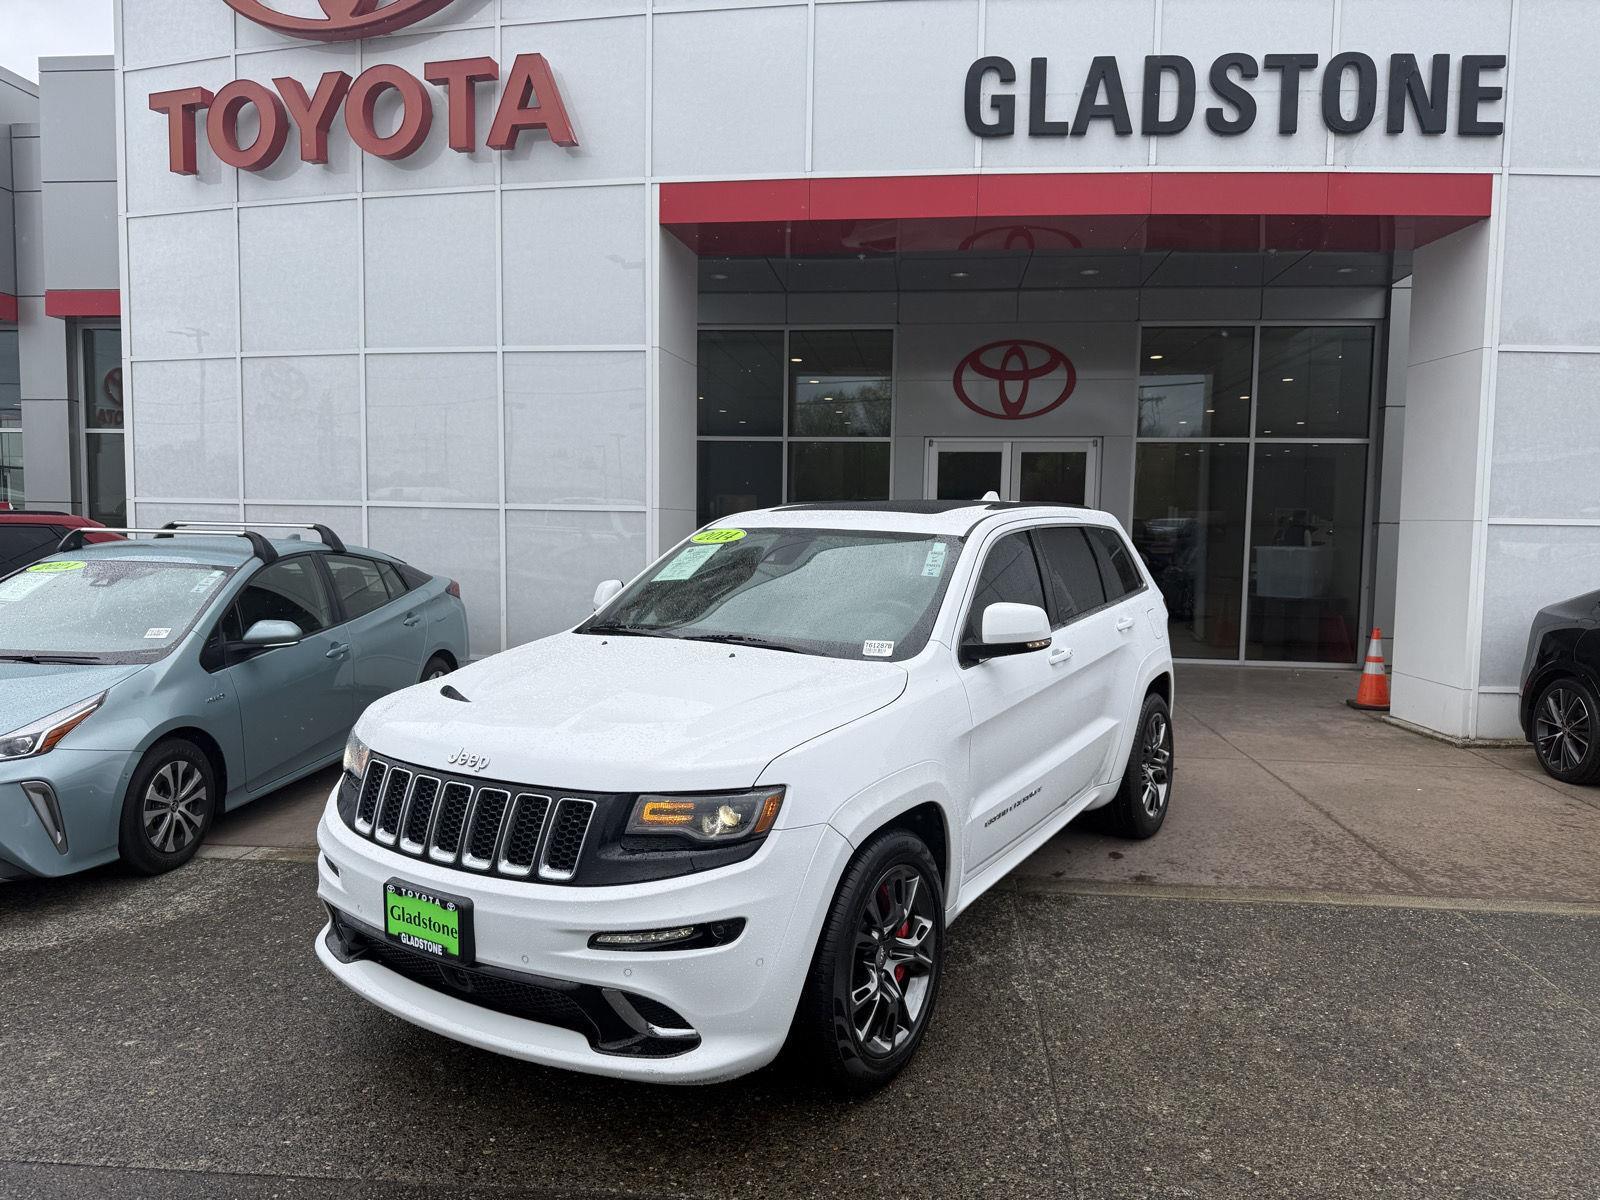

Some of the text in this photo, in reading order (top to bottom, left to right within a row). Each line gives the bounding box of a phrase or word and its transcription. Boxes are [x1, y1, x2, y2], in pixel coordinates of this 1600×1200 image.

[964, 52, 1507, 137] GLADSTONE
[149, 53, 579, 176] TOYOTA
[447, 746, 491, 773] Jeep
[401, 888, 441, 906] TOYOTA
[389, 904, 458, 939] Gladstone
[400, 932, 443, 955] GLADSTONE
